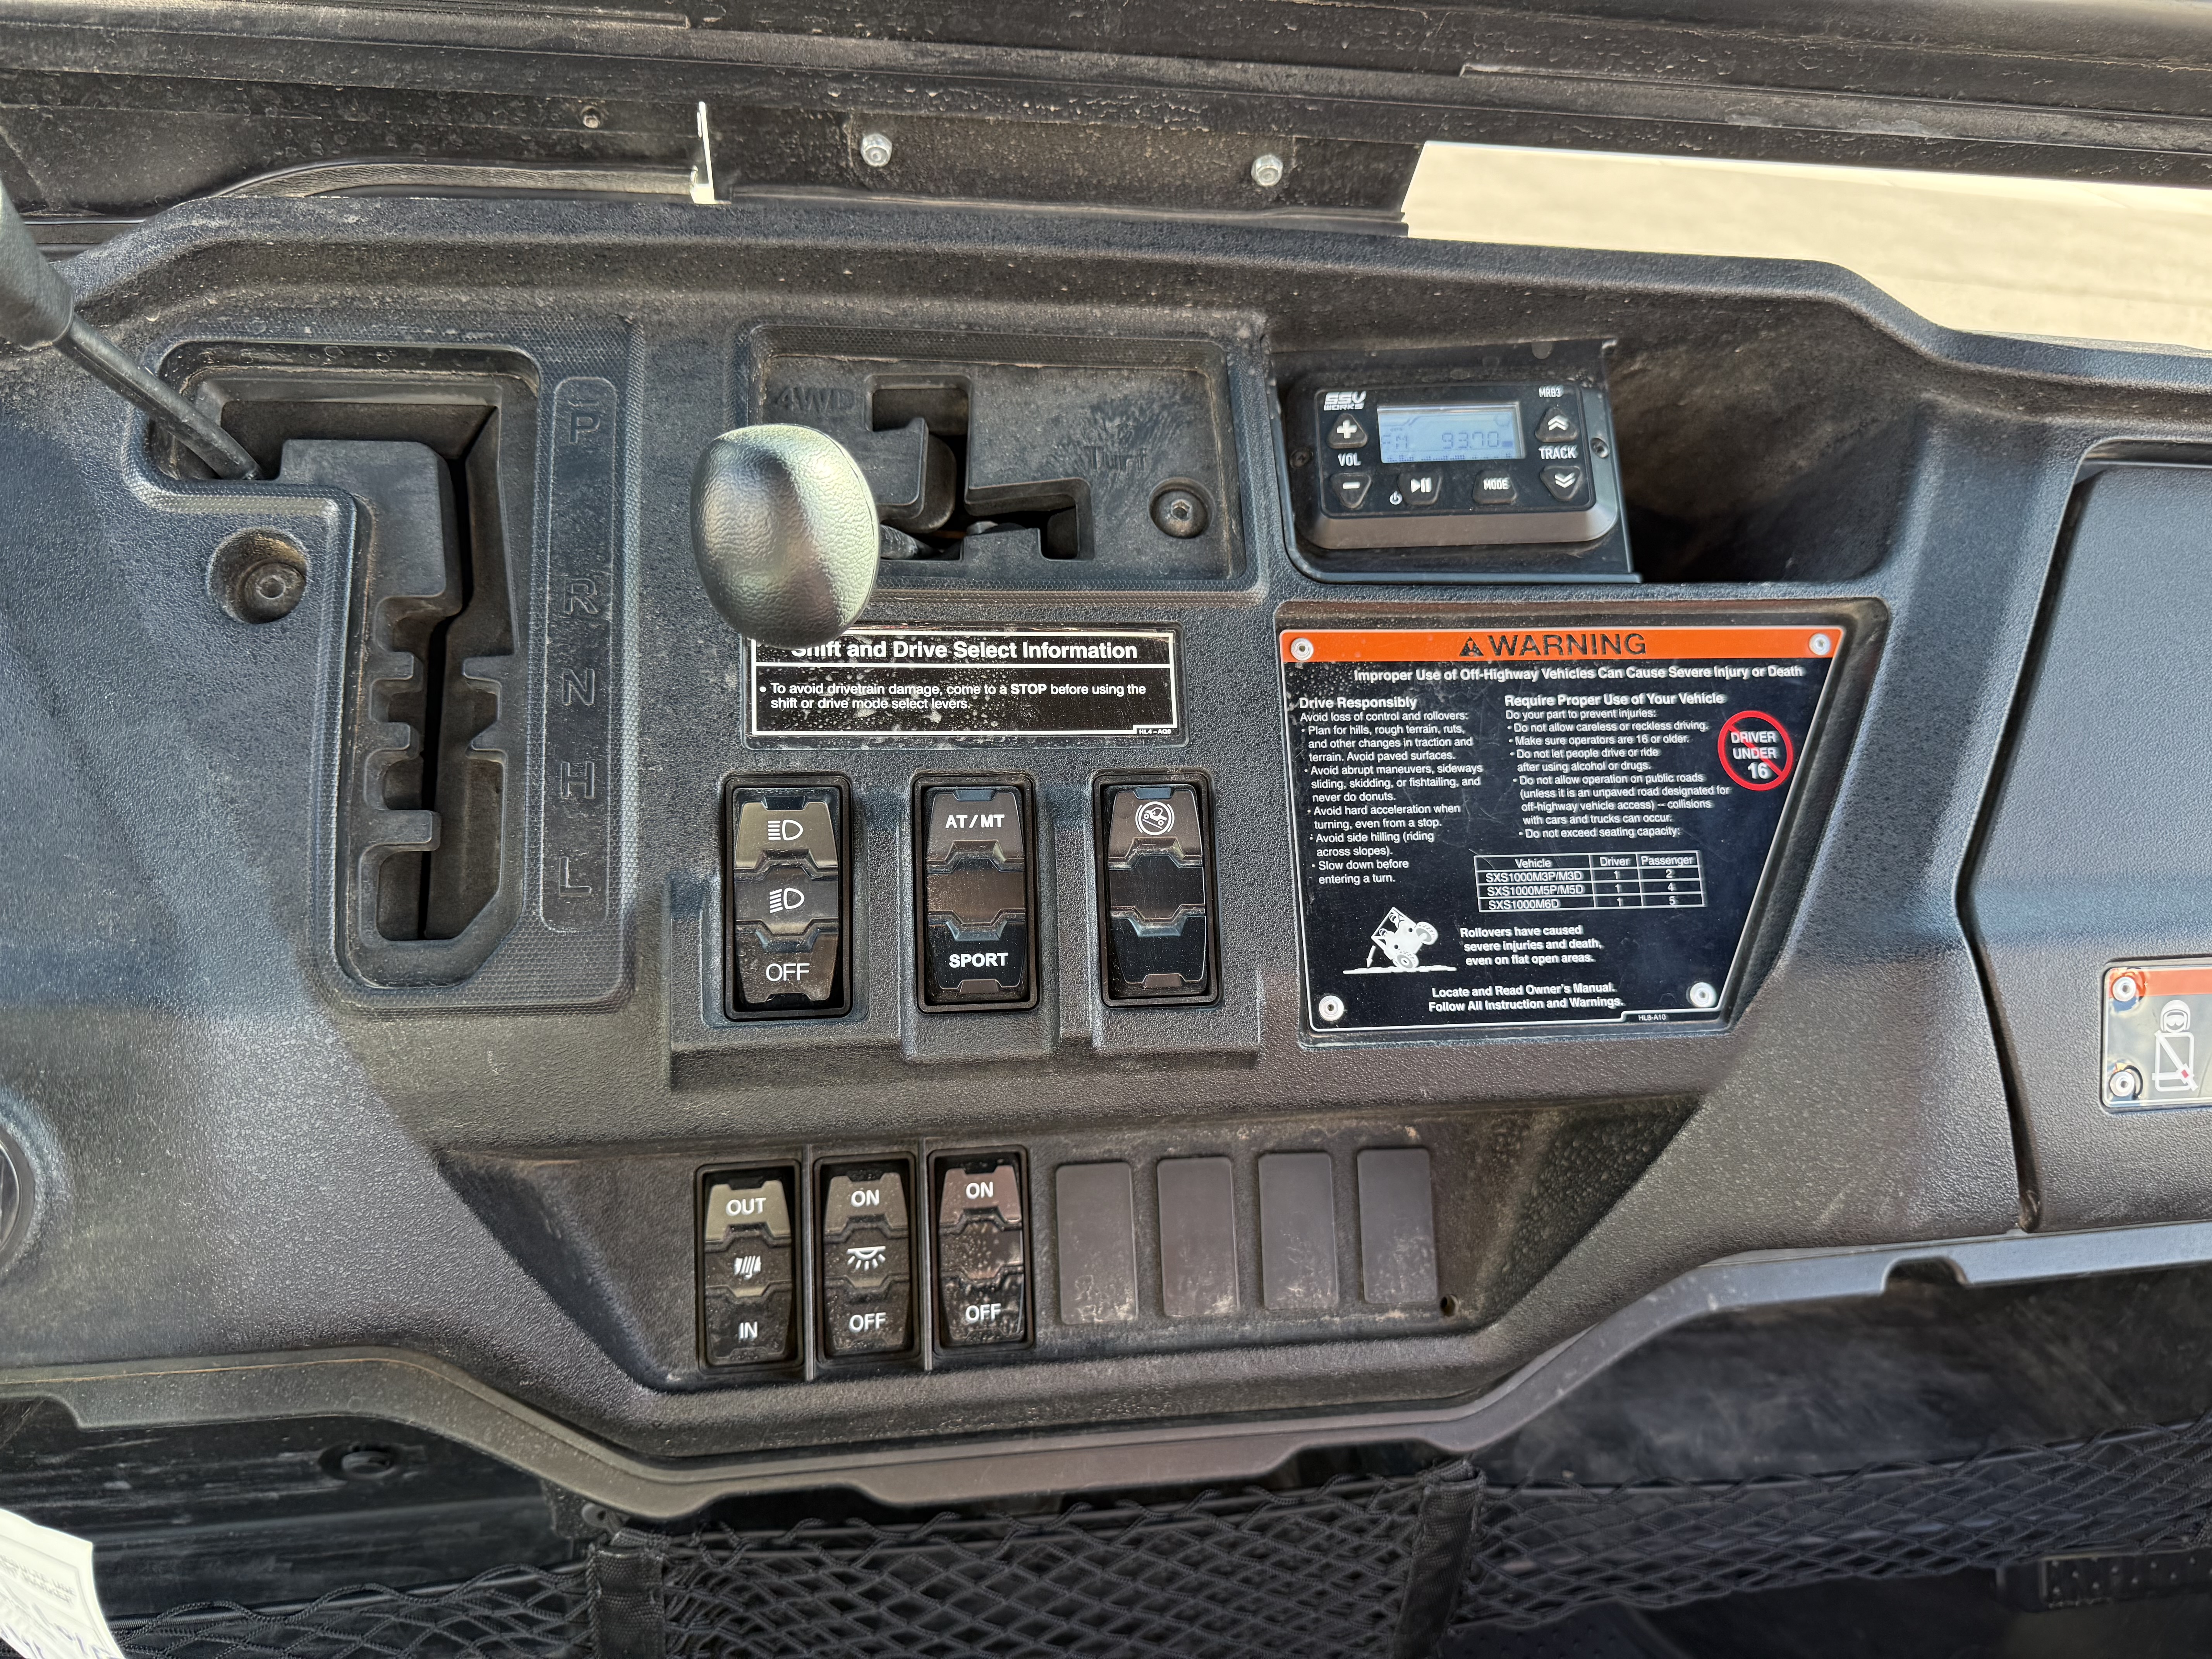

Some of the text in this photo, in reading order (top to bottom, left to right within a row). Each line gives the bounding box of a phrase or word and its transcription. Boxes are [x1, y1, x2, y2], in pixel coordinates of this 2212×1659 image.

[1325, 391, 1367, 404] SSV
[1324, 402, 1364, 411] WORKS
[569, 410, 601, 445] P
[1338, 452, 1361, 466] VOL
[1538, 445, 1578, 460] TRACK
[1483, 477, 1510, 490] MODE
[564, 578, 599, 615] R
[847, 641, 886, 658] and
[893, 641, 948, 658] Drive
[953, 641, 1017, 658] Select
[1023, 642, 1137, 659] Information
[1487, 633, 1646, 656] WARNING
[1354, 665, 1804, 684] Improper Use of Off-Highway Vehicles Can Cause Severe Injury or Death
[562, 668, 595, 706] N
[770, 682, 1146, 697] To avoid drivetrain damage, come to a STOP before using the
[771, 697, 972, 709] shift or drive mode select levers.
[1299, 696, 1418, 711] Drive Responsibly
[1504, 692, 1726, 709] Require Proper Use of Your Vehicle
[1300, 711, 1468, 722] Avoid loss of control and rollovers:
[1308, 723, 1465, 737] Plan for hills, rough terrain, ruts,
[1731, 730, 1779, 744] DRIVER
[1308, 737, 1474, 750] and other changes in traction and
[1309, 750, 1456, 763] terrain. Avoid paved surfaces.
[1733, 747, 1780, 760] UNDER
[1310, 764, 1484, 776] Avoid abrupt maneuvers, sideways
[1748, 761, 1772, 779] 16
[560, 761, 596, 799] H
[1311, 779, 1346, 791] sliding,
[1349, 778, 1394, 790] skidding,
[1409, 777, 1459, 788] fishtailing,
[1462, 776, 1481, 786] and
[1312, 792, 1396, 802] never do donuts.
[1314, 804, 1461, 816] Avoid hard acceleration when
[945, 814, 1005, 829] AT/MT
[1314, 818, 1442, 831] turning, even from a stop.
[1316, 831, 1435, 844] Avoid side hilling (riding
[1316, 845, 1393, 857] across slopes).
[1319, 859, 1409, 871] Slow down before
[1515, 855, 1695, 869] Vehicle Driver Passenger
[559, 856, 593, 897] L
[1319, 874, 1360, 886] entering
[1372, 873, 1395, 883] turn.
[1486, 869, 1676, 883] SXS1000M3P/M3D 1 2
[1487, 882, 1677, 896] SXS1000M5P/M5D 1 4
[1488, 895, 1678, 910] SXS1000M6D 1 5
[1460, 924, 1583, 938] Rollovers have caused
[949, 952, 1009, 968] SPORT
[765, 963, 810, 982] OFF
[1432, 982, 1615, 998] Locate and Read Owner's Manual.
[1428, 996, 1624, 1012] Follow All Instruction and Warnings.
[966, 1181, 994, 1199] ON
[851, 1189, 880, 1207] ON
[726, 1197, 766, 1216] OUT
[965, 1303, 1001, 1324] OFF
[849, 1312, 886, 1332] OFF
[739, 1321, 758, 1339] IN
